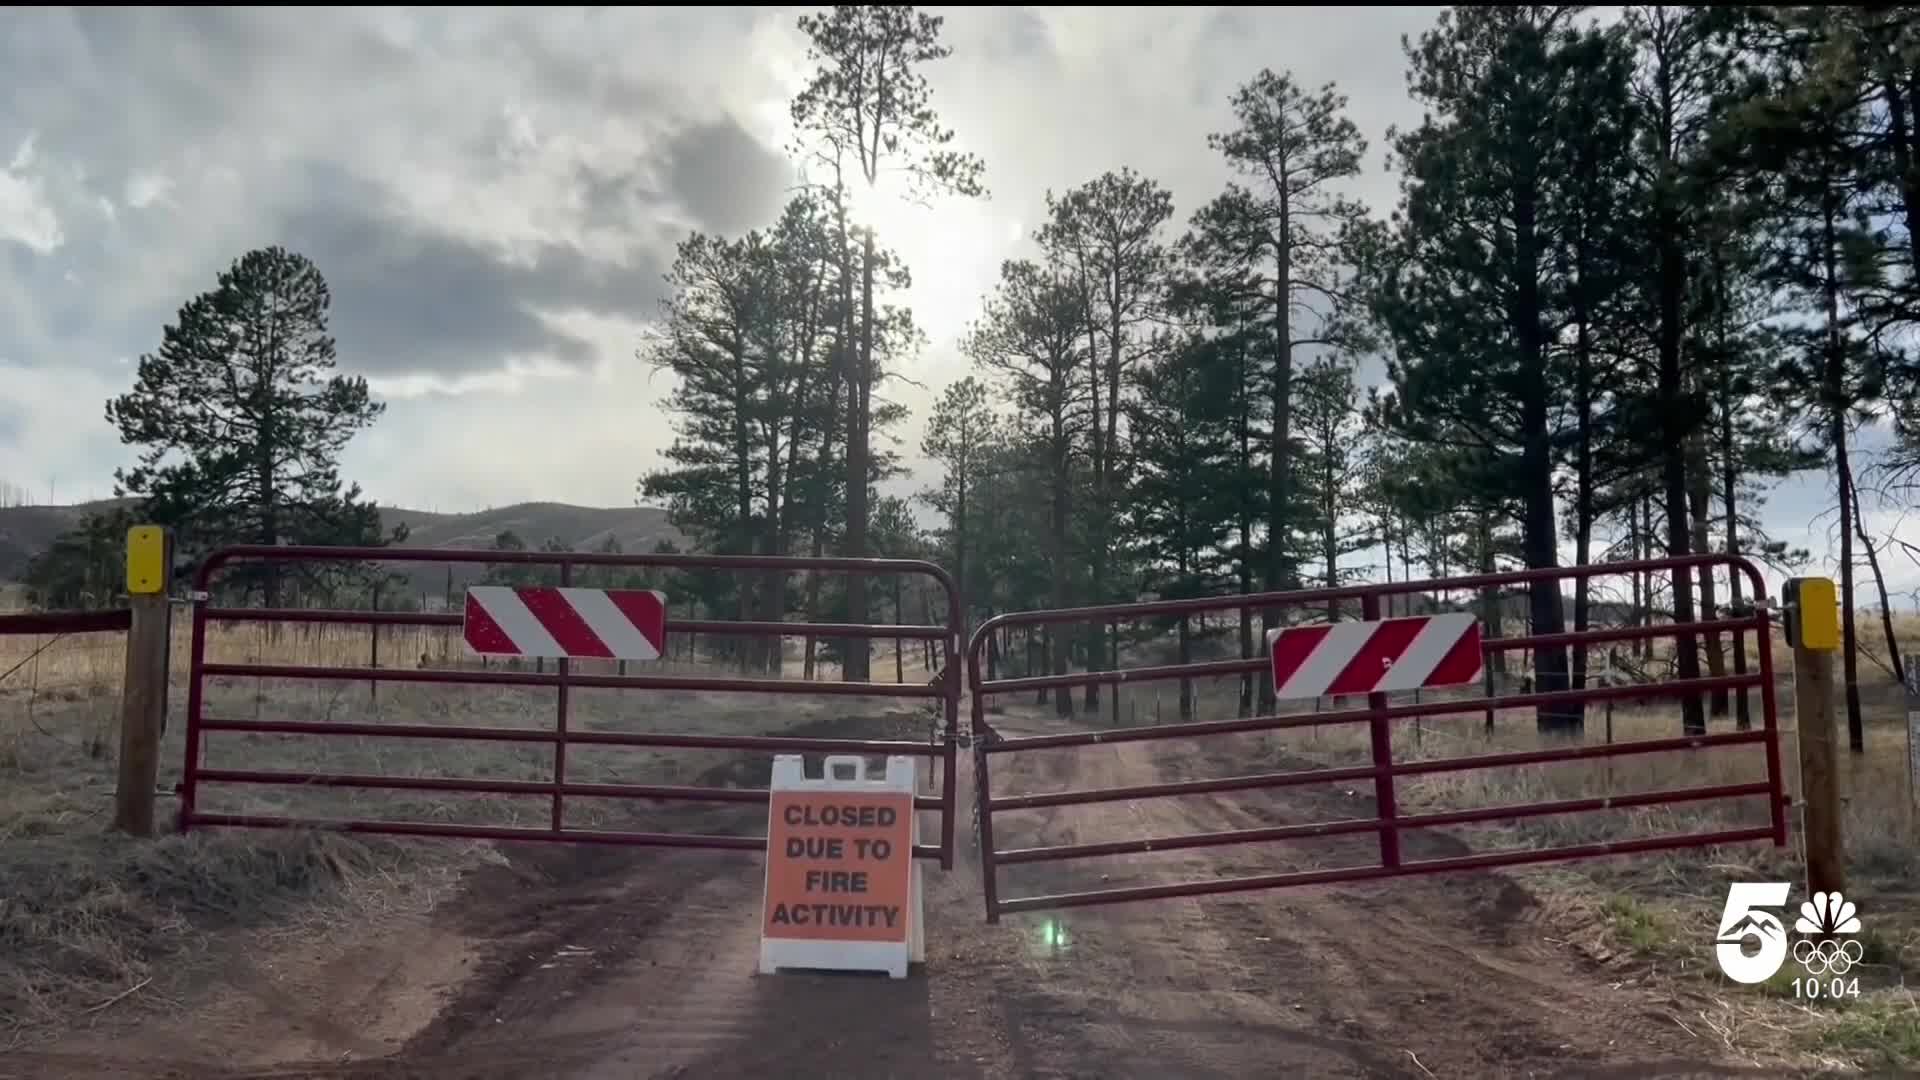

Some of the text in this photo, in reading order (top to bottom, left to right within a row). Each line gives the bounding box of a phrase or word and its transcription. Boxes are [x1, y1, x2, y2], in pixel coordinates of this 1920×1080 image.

[784, 804, 896, 827] CLOSED
[786, 837, 891, 860] DUE TO
[805, 871, 868, 893] FIRE
[771, 903, 899, 927] ACTIVITY
